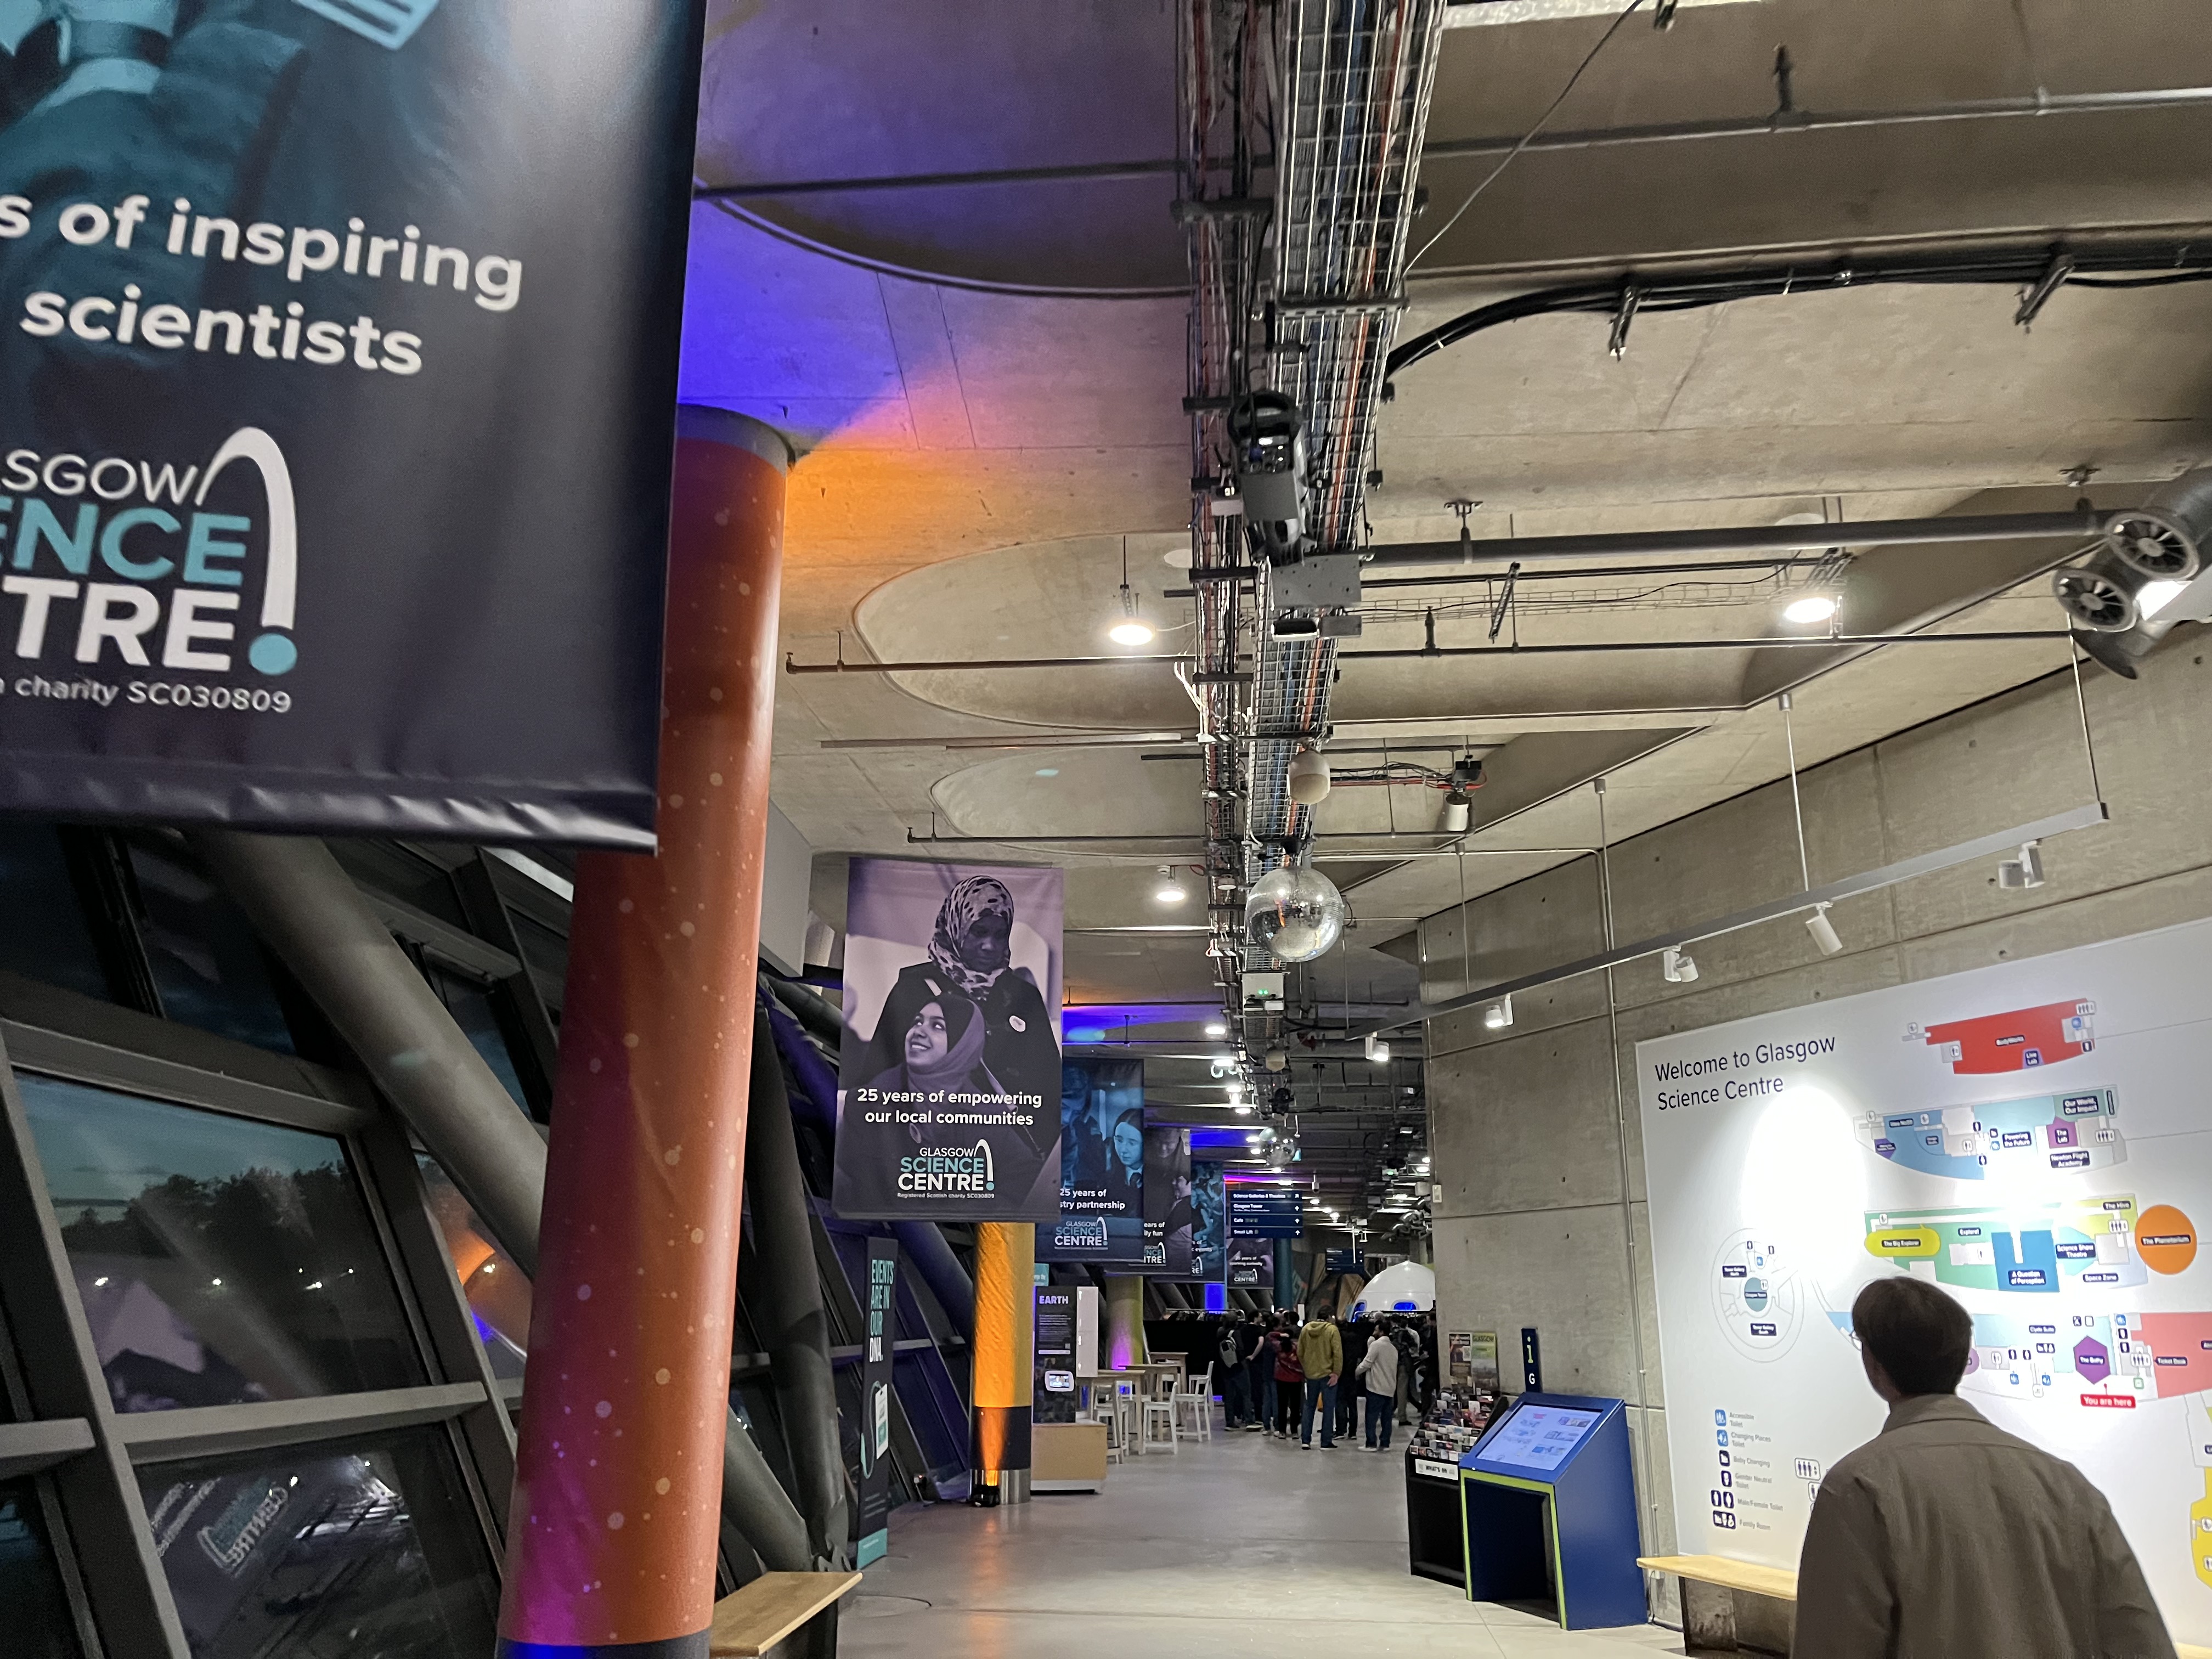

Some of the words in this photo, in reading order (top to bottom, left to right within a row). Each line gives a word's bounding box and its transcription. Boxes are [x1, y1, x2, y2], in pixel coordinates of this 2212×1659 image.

[58, 195, 150, 249] of
[167, 198, 522, 312] inspiring
[20, 283, 422, 375] scientists
[2, 449, 198, 505] SGOW
[0, 495, 250, 586] NCE
[15, 675, 119, 707] charity
[127, 681, 291, 713] SC030809
[1655, 1057, 1728, 1081] Welcome
[1733, 1051, 1750, 1068] to
[1756, 1037, 1835, 1063] Glasgow
[857, 1088, 878, 1102] 25
[882, 1091, 924, 1105] years
[929, 1090, 945, 1103] of
[948, 1091, 1042, 1108] empowering
[1658, 1088, 1719, 1110] Science
[1725, 1077, 1783, 1099] Centre
[865, 1112, 891, 1122] our
[896, 1110, 932, 1123] local
[936, 1111, 1034, 1125] communities
[919, 1147, 974, 1157] GLASGOW
[900, 1157, 984, 1173] SCIENCE
[1073, 1189, 1096, 1198] years
[1097, 1189, 1107, 1197] of
[1077, 1201, 1125, 1210] partnership
[1056, 1227, 1102, 1236] SCIENCE
[1039, 1296, 1069, 1304] EARTH
[1528, 1373, 1535, 1384] G
[2084, 1396, 2098, 1405] You
[2113, 1397, 2132, 1407] here
